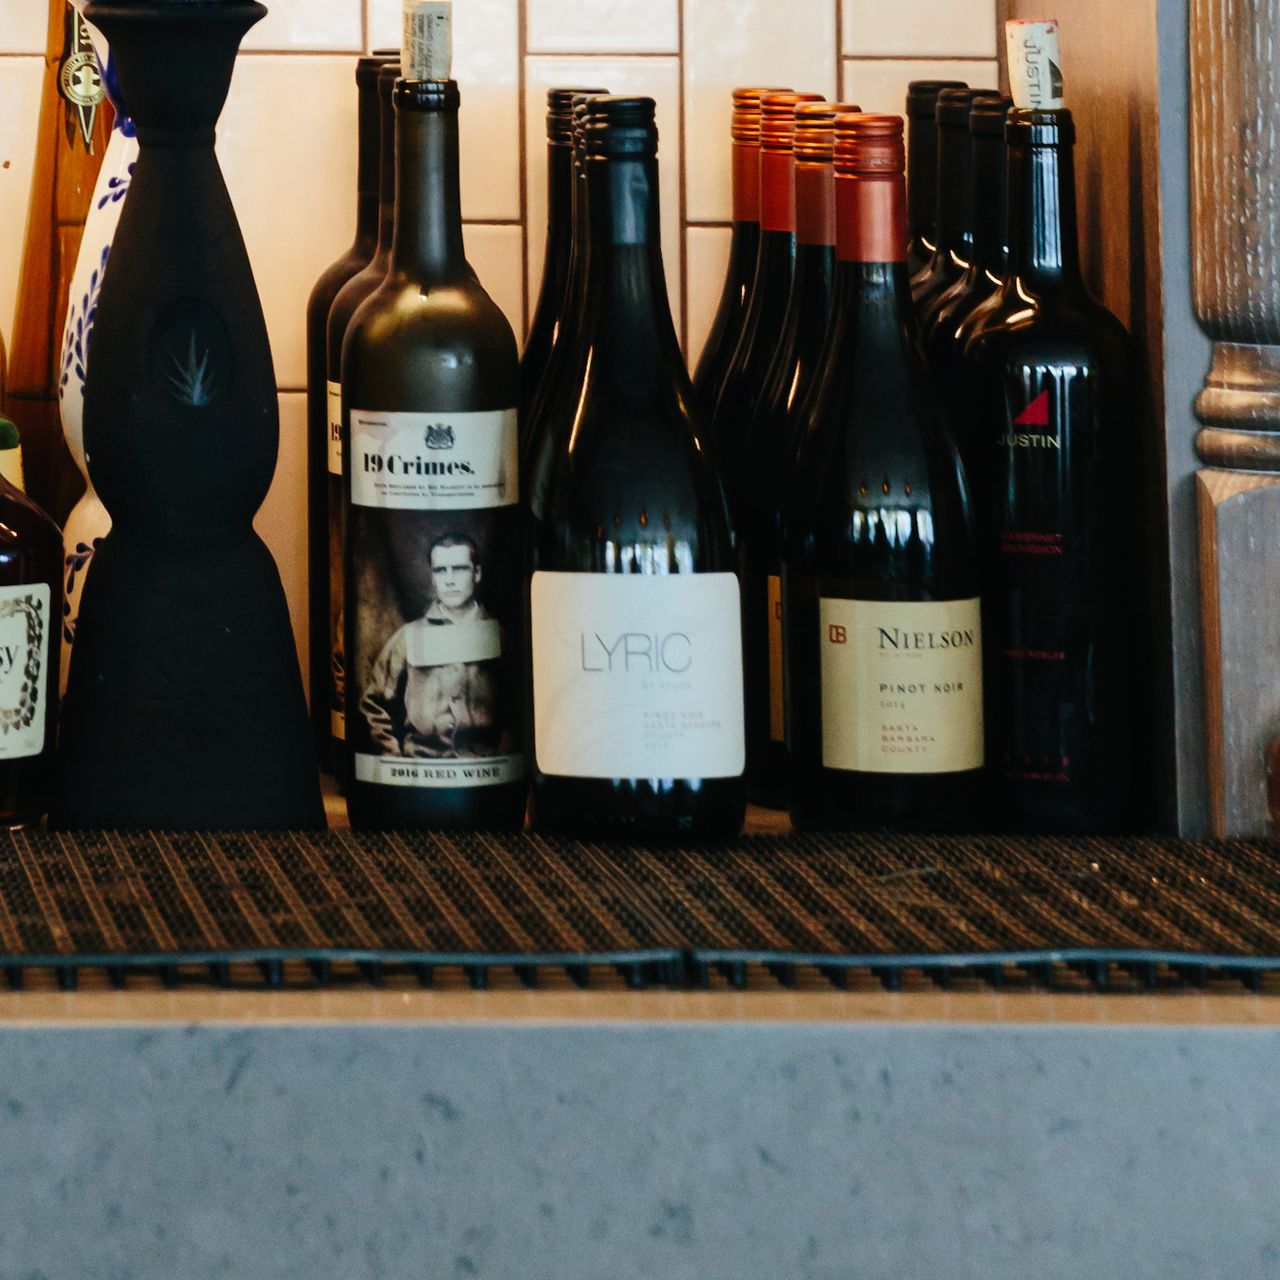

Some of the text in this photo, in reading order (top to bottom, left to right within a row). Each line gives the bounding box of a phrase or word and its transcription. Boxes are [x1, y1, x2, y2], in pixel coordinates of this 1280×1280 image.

[996, 433, 1062, 449] JUSTIN
[363, 452, 476, 476] 19 Crimes.
[580, 632, 693, 673] LYRIC
[879, 681, 964, 694] PINOT NOIR
[390, 766, 501, 779] 2016 RED WINE
